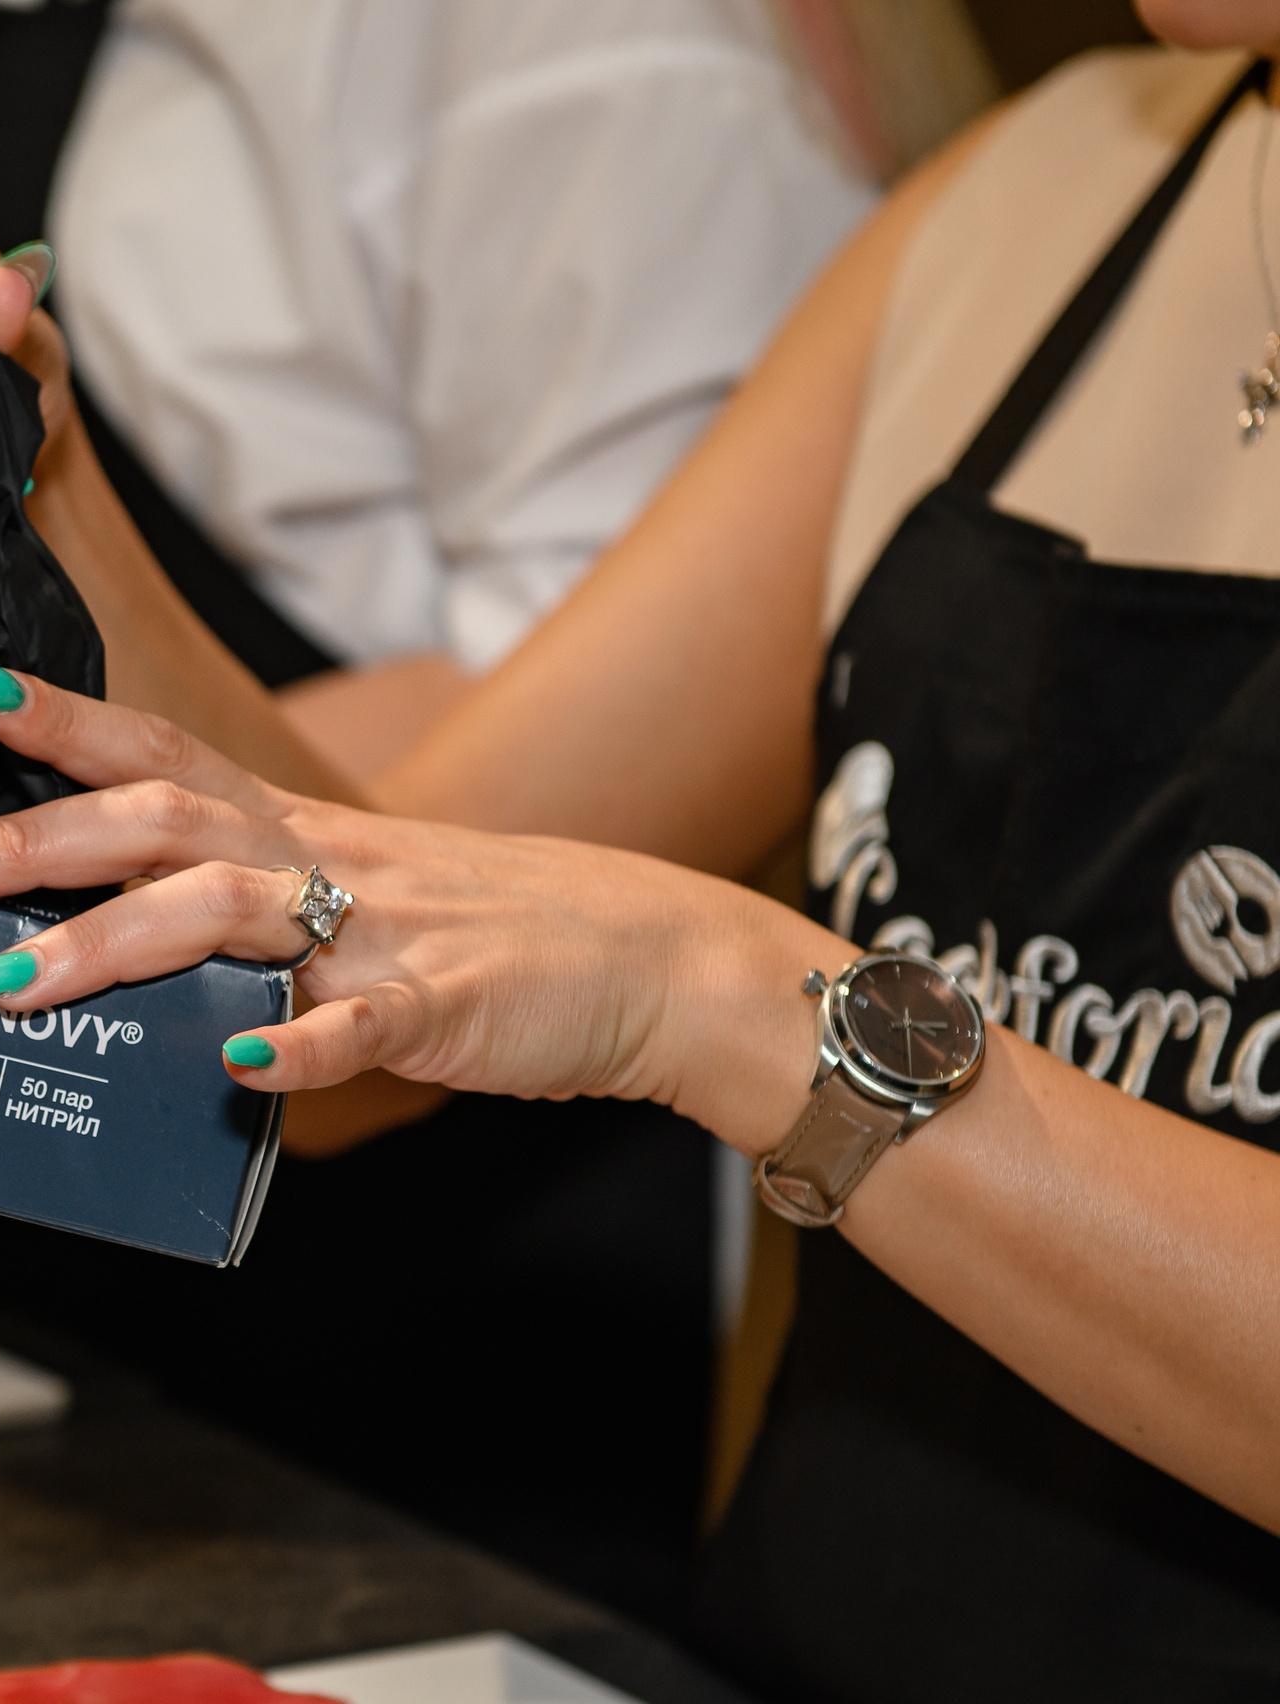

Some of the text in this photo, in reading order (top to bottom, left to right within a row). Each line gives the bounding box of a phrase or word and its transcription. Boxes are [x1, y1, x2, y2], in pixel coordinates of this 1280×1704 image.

[20, 1076, 93, 1113] 50 пар
[5, 1098, 101, 1137] НИТРИЛ
